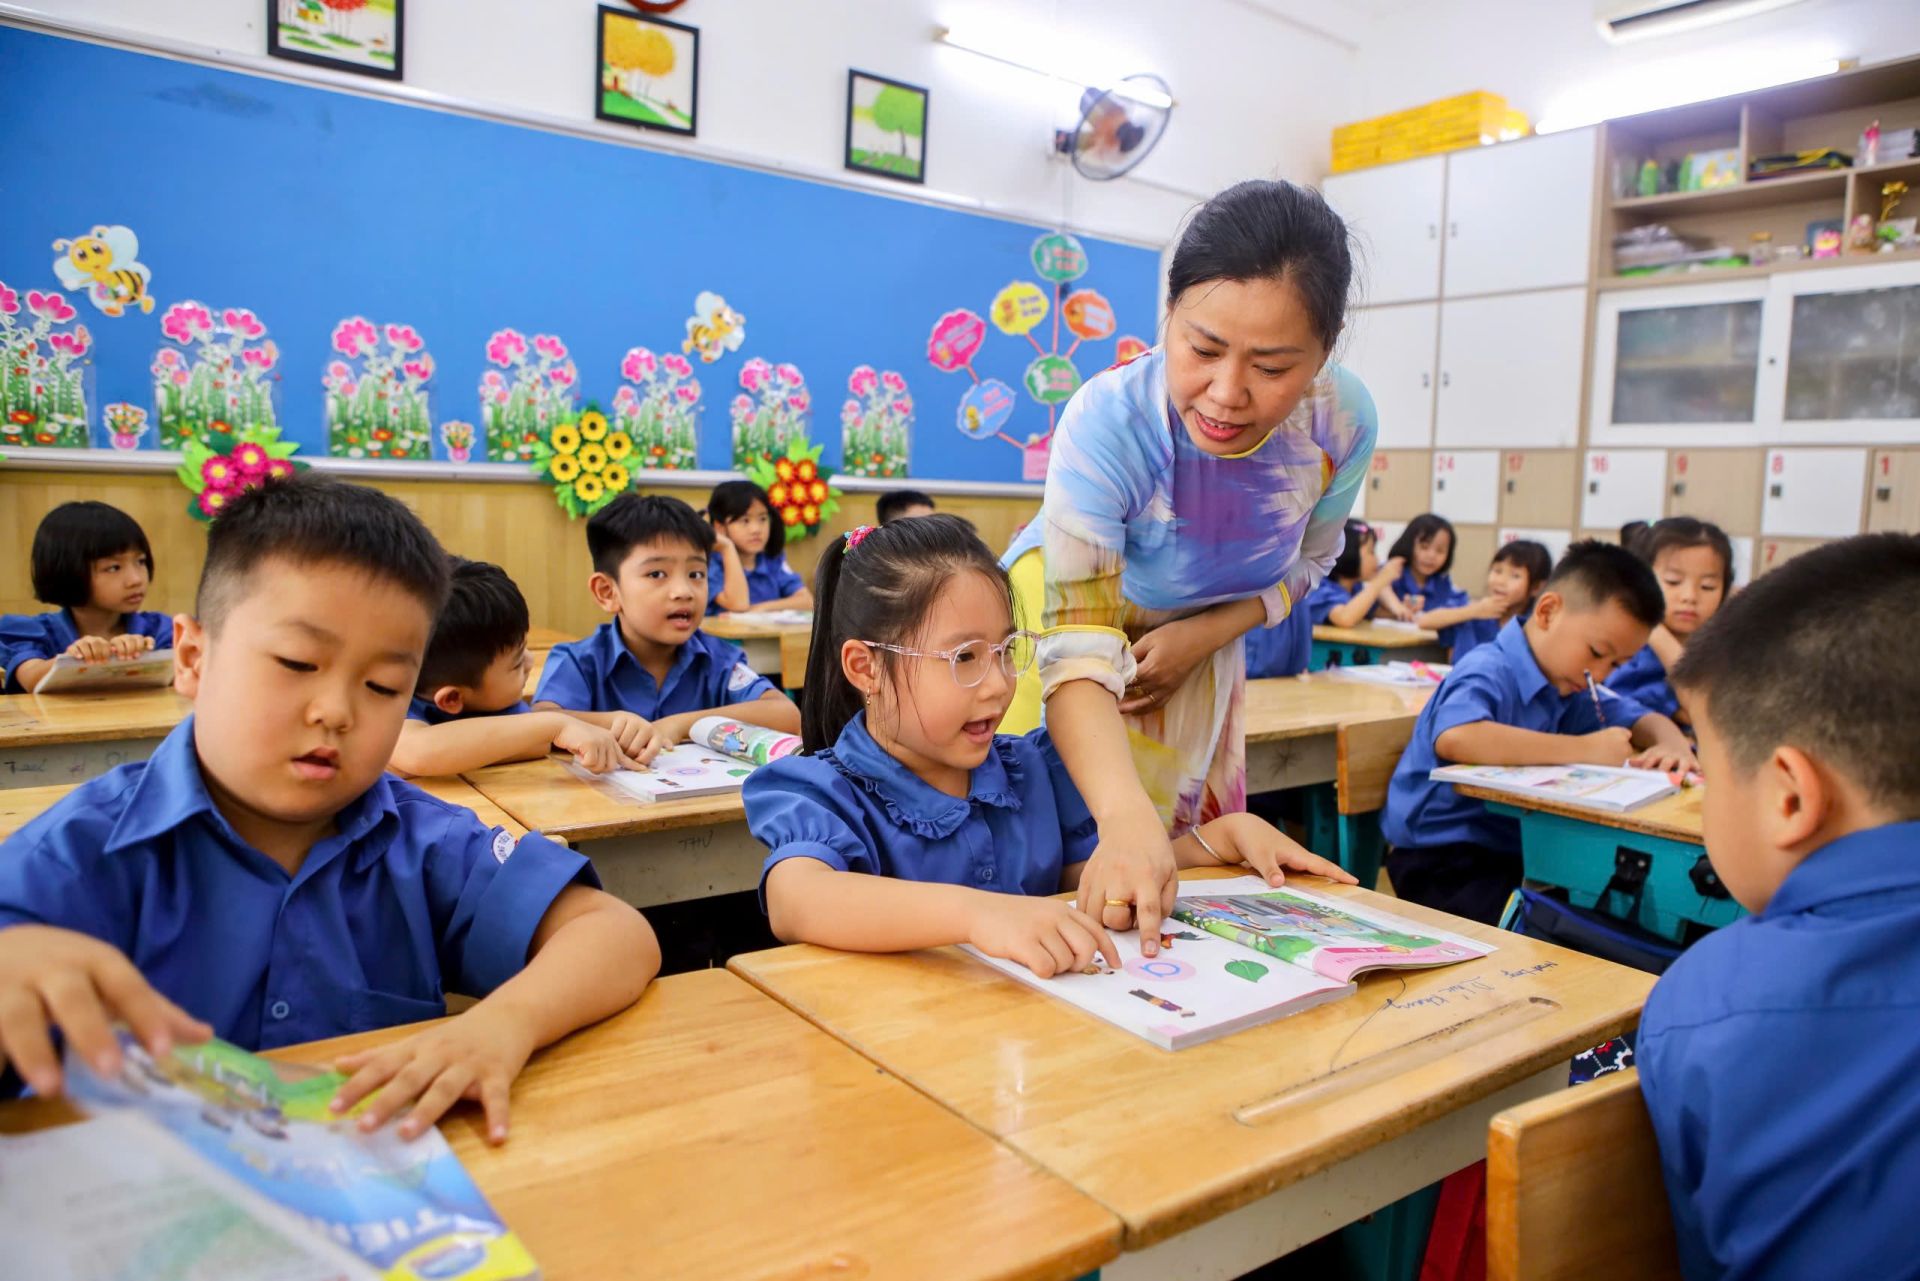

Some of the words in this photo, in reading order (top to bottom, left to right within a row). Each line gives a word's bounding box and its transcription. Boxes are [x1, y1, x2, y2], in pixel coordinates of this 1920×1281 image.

[1437, 454, 1455, 472] 24
[1507, 453, 1524, 472] 17
[1591, 454, 1609, 473] 16
[1676, 455, 1688, 474] 9
[1772, 454, 1784, 474] 8
[1880, 455, 1890, 475] 1
[1766, 543, 1777, 563] 7
